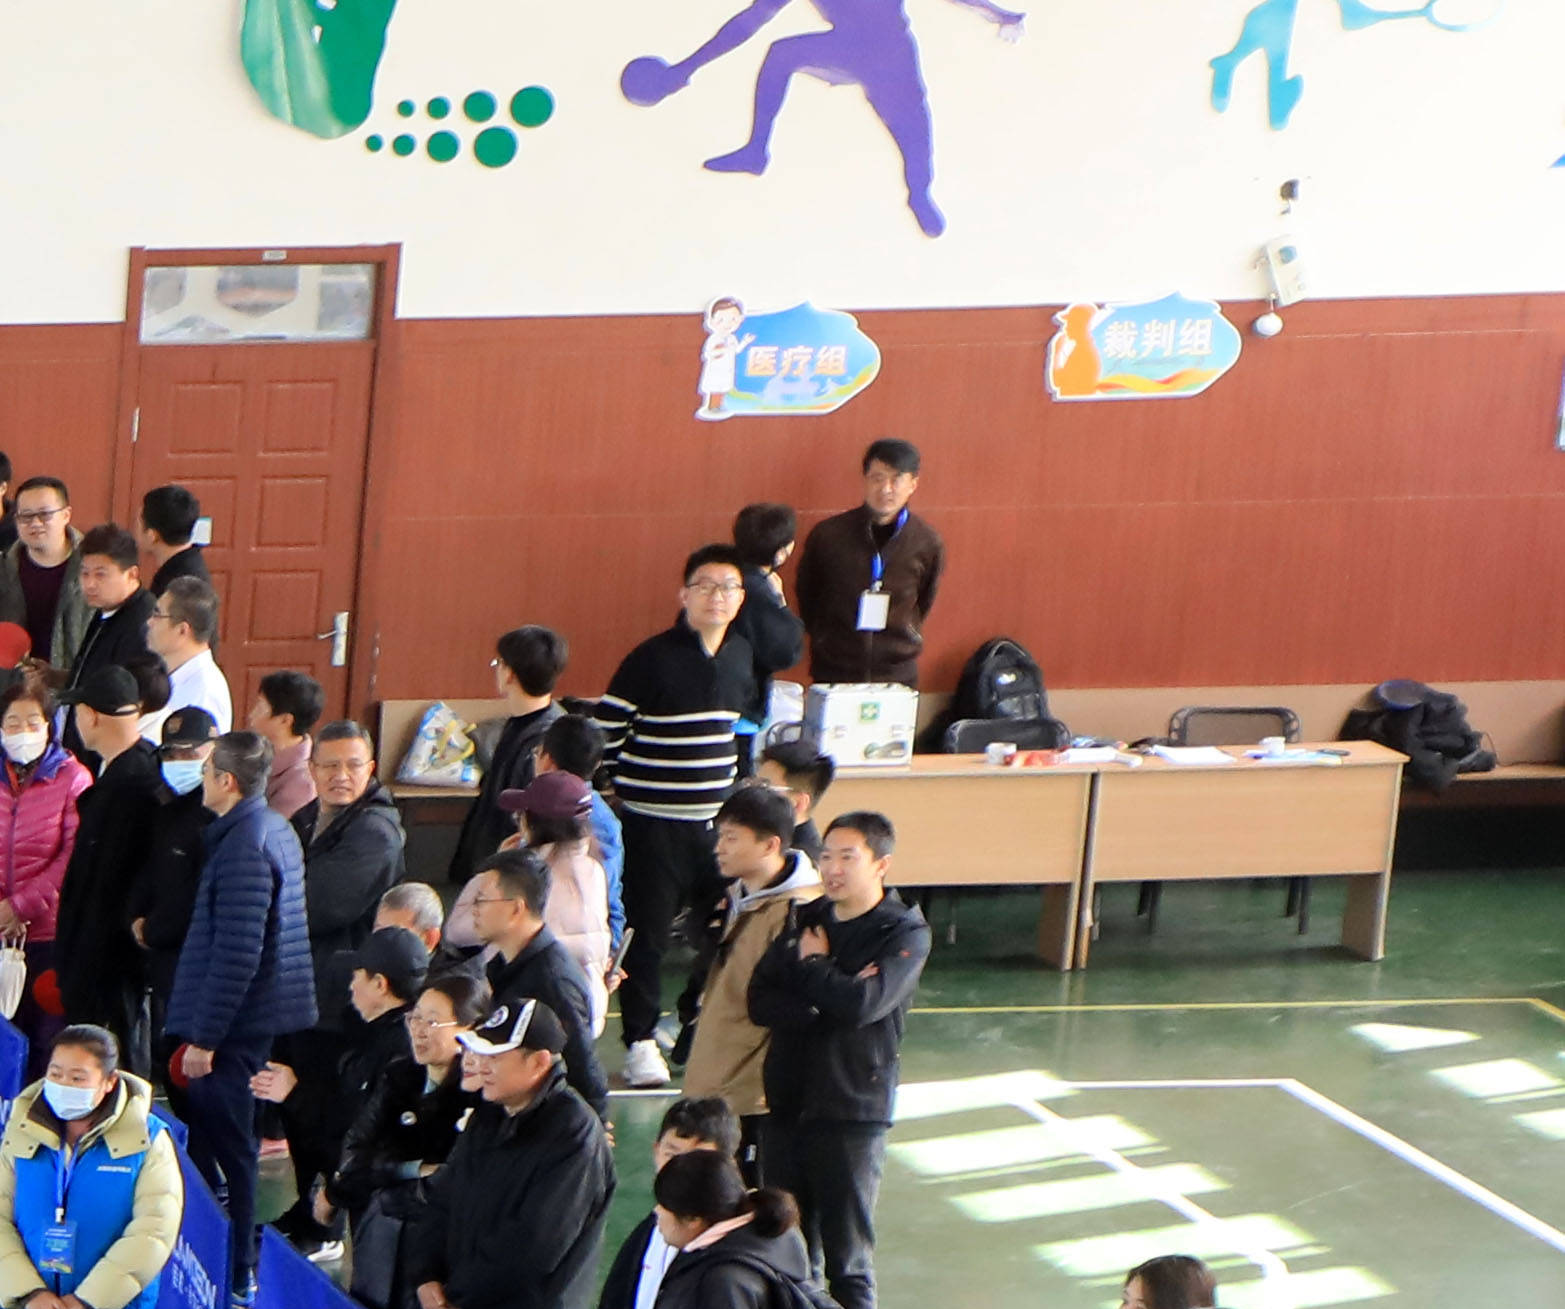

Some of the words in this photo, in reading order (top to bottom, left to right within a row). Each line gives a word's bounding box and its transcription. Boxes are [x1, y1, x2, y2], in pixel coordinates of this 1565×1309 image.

[1103, 319, 1212, 359] 裁判组
[745, 344, 848, 378] 医疗组
